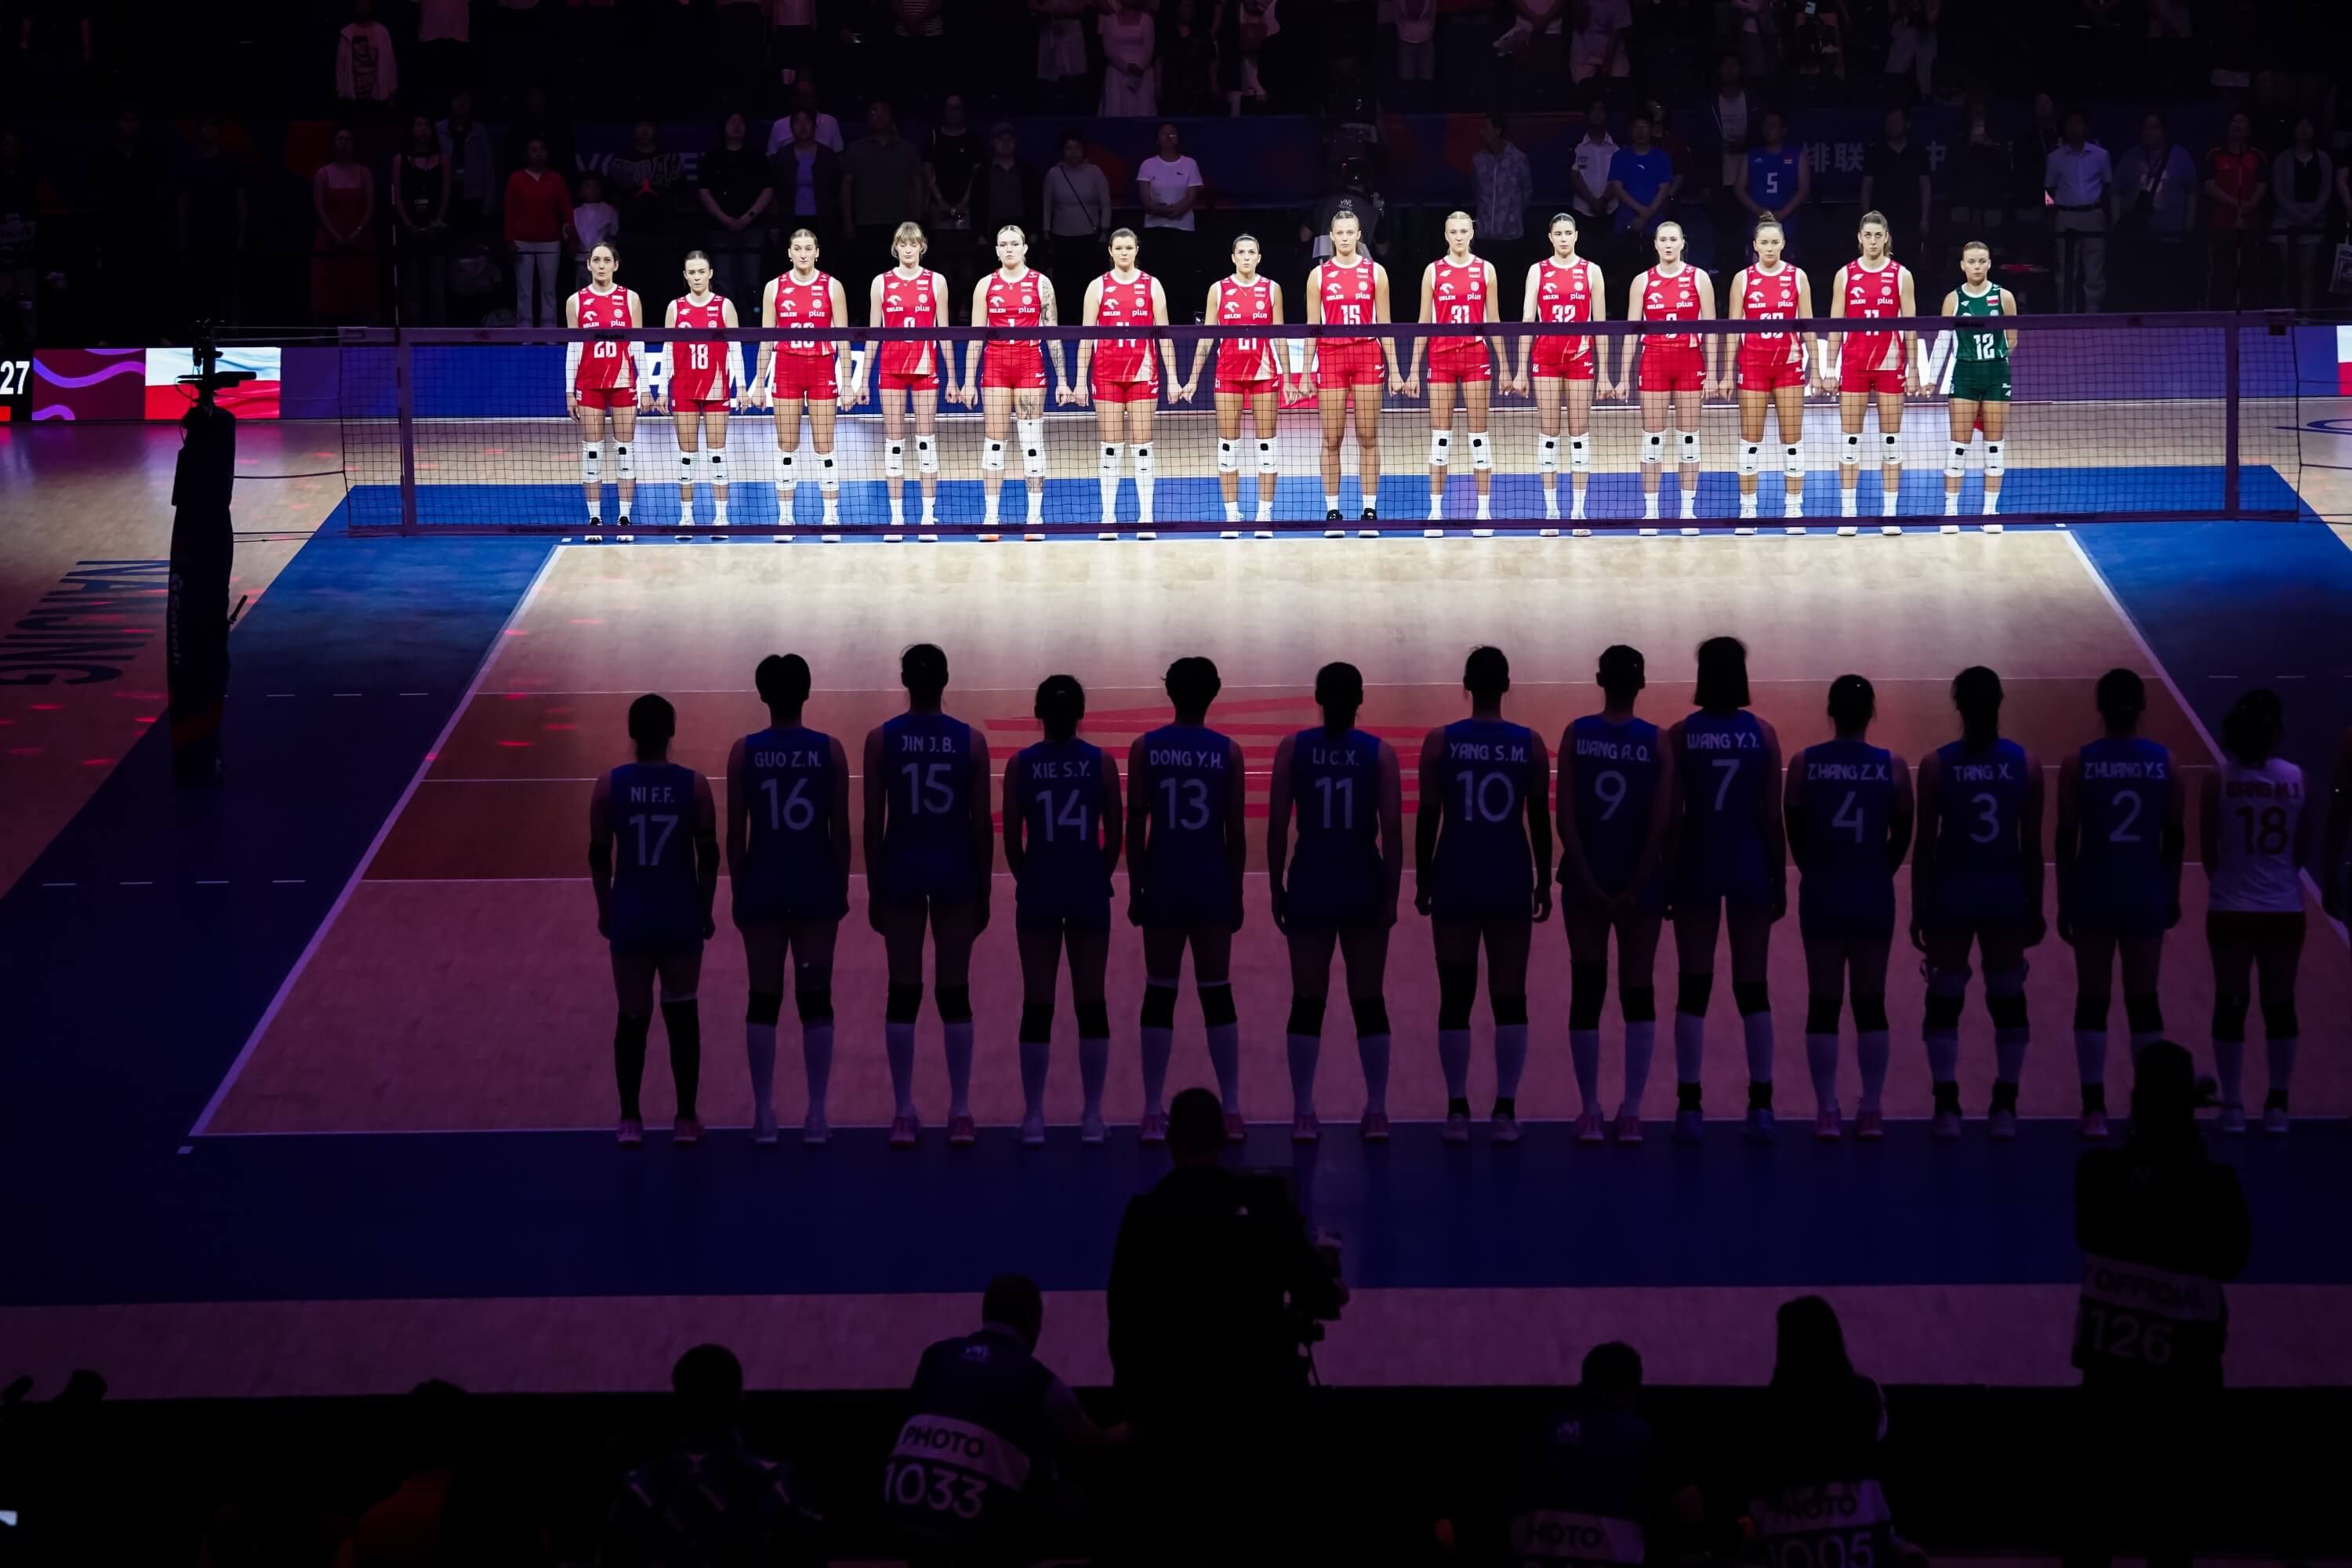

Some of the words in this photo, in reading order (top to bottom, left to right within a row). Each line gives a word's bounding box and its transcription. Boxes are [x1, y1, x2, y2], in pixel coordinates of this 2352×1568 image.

[1766, 172, 1778, 193] 5
[809, 308, 825, 318] plus
[915, 304, 931, 313] plus
[1253, 311, 1268, 320] plus
[1341, 304, 1361, 325] 15
[1450, 305, 1469, 323] 31
[1552, 305, 1576, 323] 32
[1676, 300, 1693, 309] plus
[688, 343, 709, 369] 18
[1973, 333, 1995, 360] 12
[0, 360, 31, 394] 27
[902, 735, 924, 753] JIN
[929, 735, 957, 753] J.B.
[1450, 742, 1489, 760] YANG
[1494, 745, 1528, 763] S.M.
[1577, 739, 1618, 760] WANG
[1686, 732, 1731, 750] WANG
[754, 751, 786, 768] GUO
[1149, 750, 1192, 768] DONG
[1196, 751, 1224, 770] Y.H.
[1312, 747, 1326, 765] LI
[1031, 762, 1058, 779] XIE
[1062, 760, 1091, 778] S.Y.
[1806, 762, 1857, 781] ZHANG
[1951, 764, 1994, 782] TANG
[1997, 762, 2014, 780] X.
[2084, 761, 2141, 779] ZHUANG
[630, 786, 647, 803] NI
[652, 787, 675, 804] F.F.
[901, 762, 955, 815] 15
[1455, 769, 1515, 822] 10
[1594, 770, 1628, 822] 9
[1712, 758, 1741, 811] 7
[760, 778, 815, 831] 16
[1159, 777, 1210, 831] 13
[1314, 776, 1354, 830] 11
[1035, 788, 1088, 843] 14
[1831, 790, 1864, 844] 4
[1969, 792, 2001, 844] 3
[2108, 789, 2144, 844] 2
[628, 813, 679, 866] 17
[2236, 805, 2288, 855] 18
[2089, 1310, 2176, 1367] 126
[902, 1425, 985, 1458] PHOTO
[884, 1460, 988, 1519] 1033
[1527, 1523, 1600, 1548] HOTO
